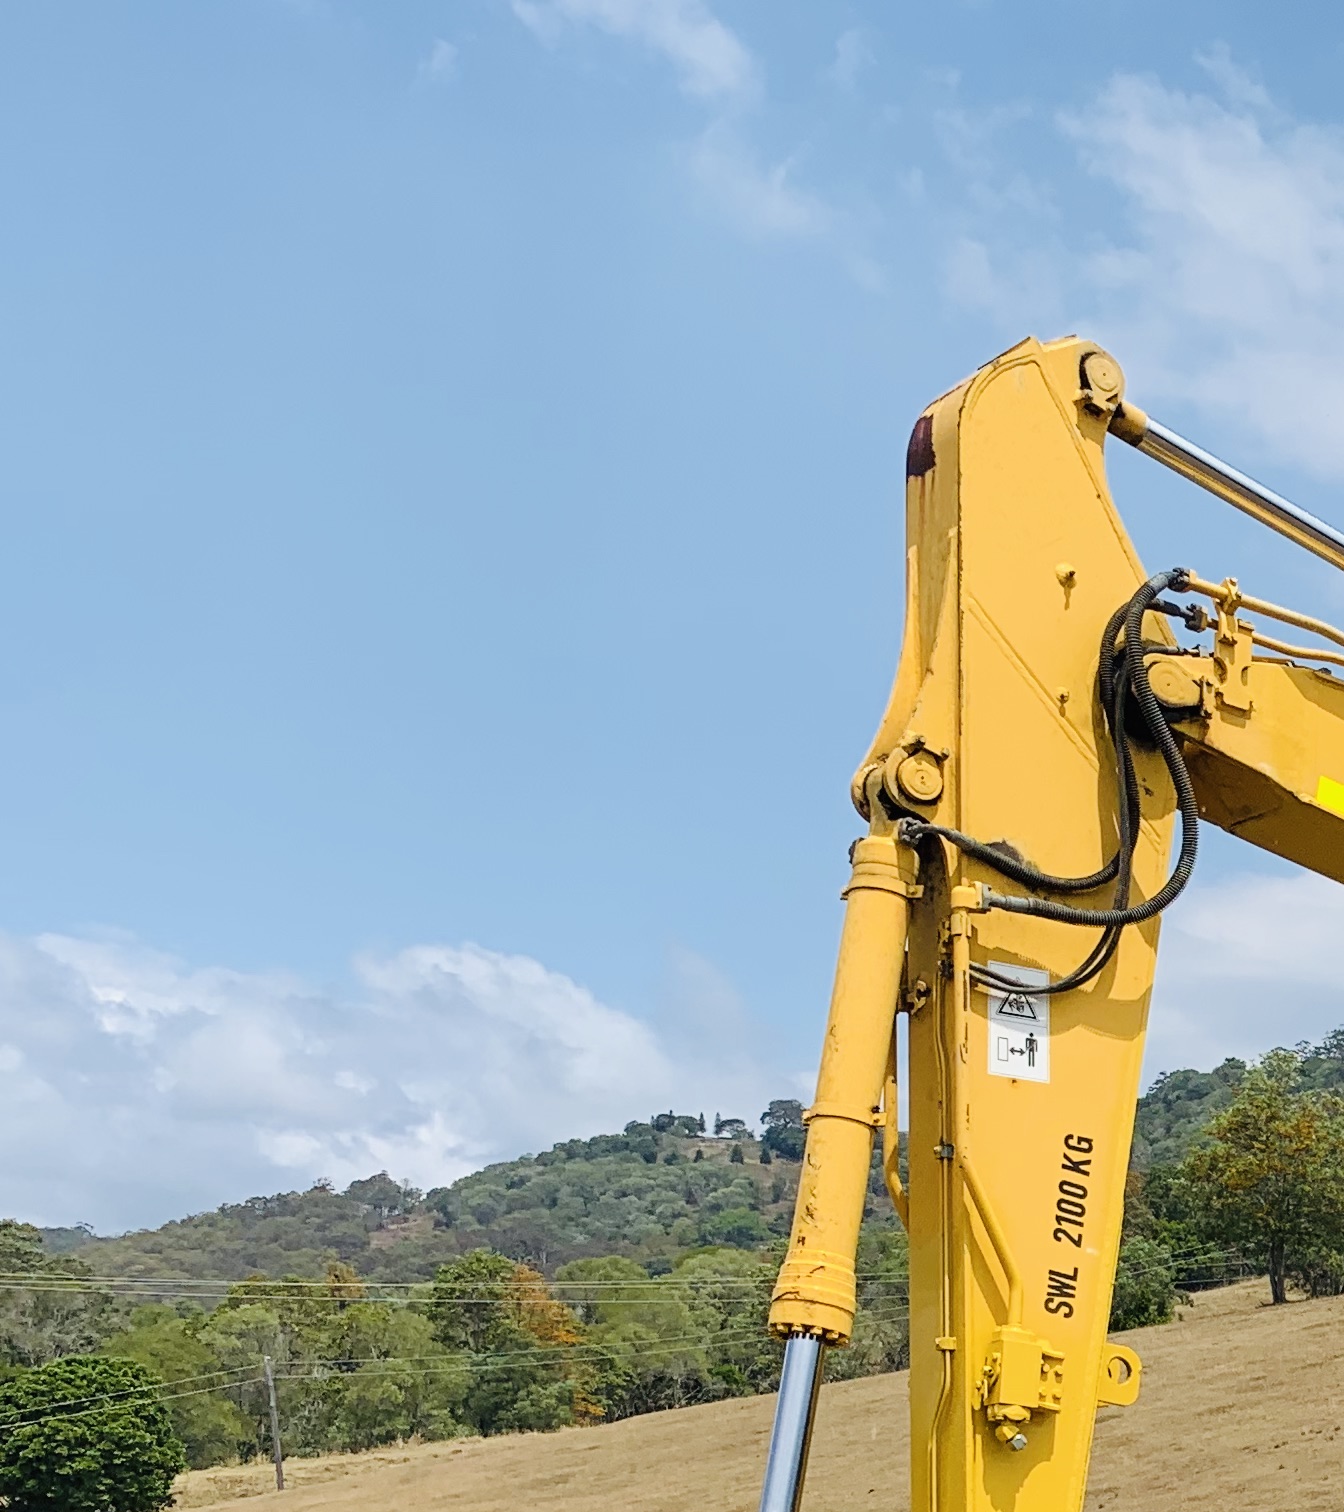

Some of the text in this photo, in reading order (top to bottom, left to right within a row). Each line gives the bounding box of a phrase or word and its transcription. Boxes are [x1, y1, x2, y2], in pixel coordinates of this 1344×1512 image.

[1044, 1134, 1094, 1319] SWL 2100 KG
